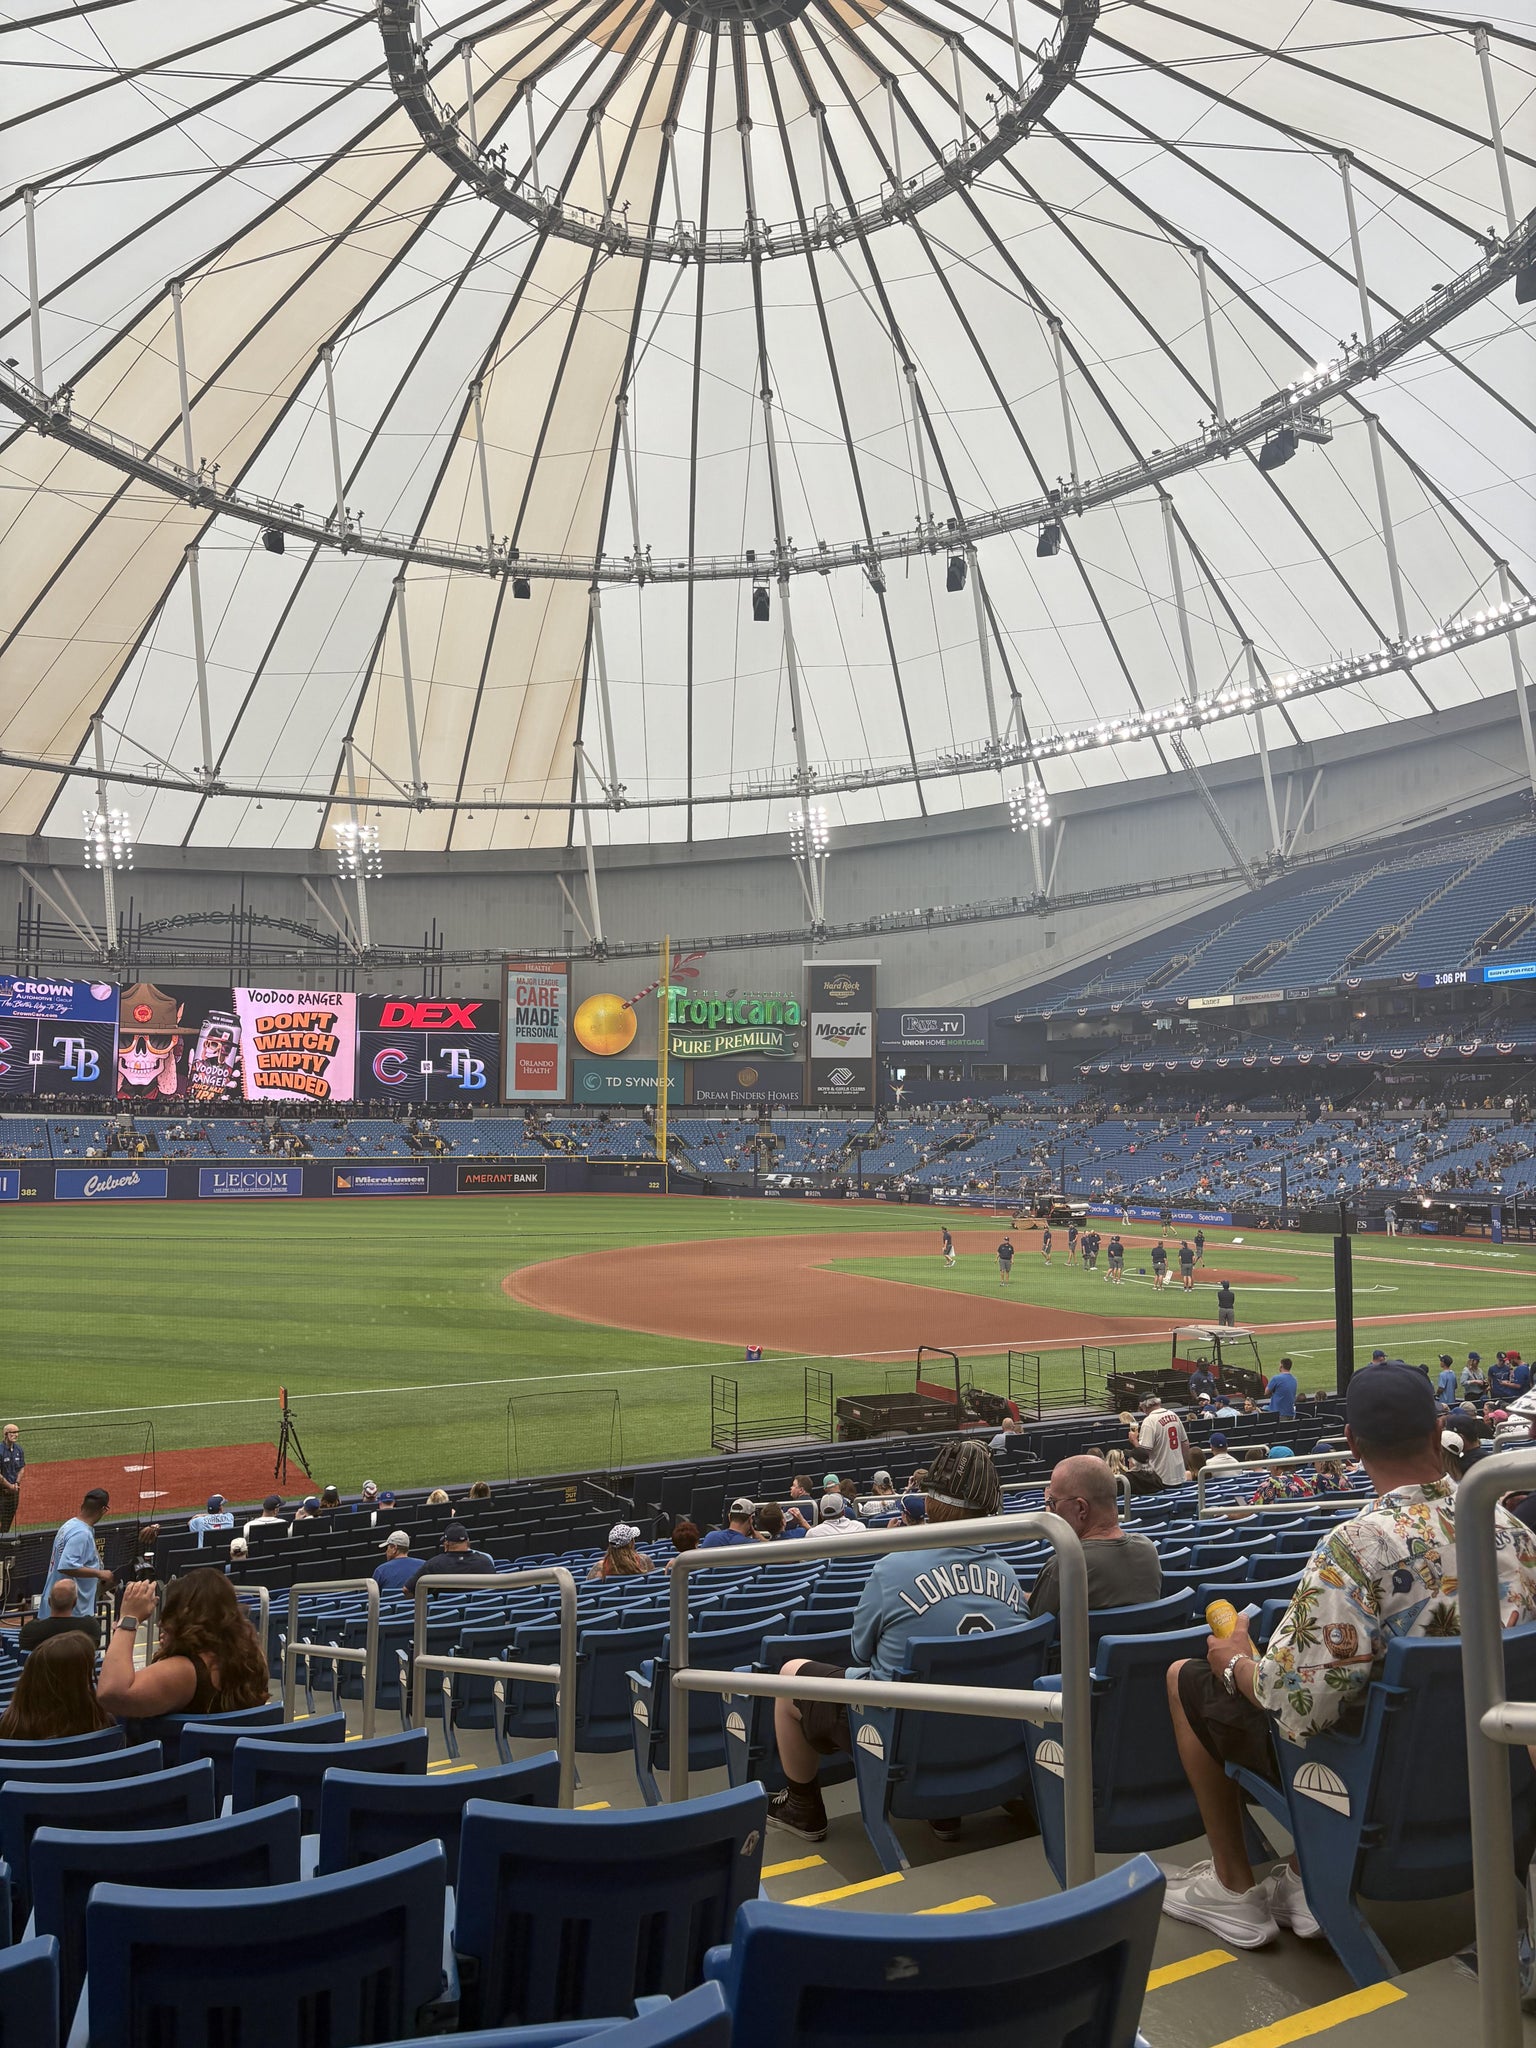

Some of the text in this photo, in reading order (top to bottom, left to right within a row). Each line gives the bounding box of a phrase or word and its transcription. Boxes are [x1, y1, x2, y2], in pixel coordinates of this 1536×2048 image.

[516, 977, 559, 987] MAJOR LEAGUE
[824, 981, 860, 991] Hard Rock
[1434, 971, 1467, 985] 3:06 PM
[12, 981, 74, 997] CROWN
[516, 985, 560, 1008] CARE
[1, 997, 13, 1007] The
[16, 993, 53, 1002] AUTOMOTIVE
[247, 990, 343, 1006] VOODOO RANGER
[12, 1010, 58, 1018] CrownCars.com
[657, 985, 801, 1029] Tropicana
[255, 1012, 338, 1034] DON'T
[379, 1002, 483, 1029] DEX
[516, 1007, 559, 1027] MADE
[516, 1026, 559, 1039] PERSONAL
[816, 1023, 867, 1036] Mosaic
[253, 1032, 340, 1057] WATCH
[672, 1032, 783, 1054] PURE PREMIUM
[53, 1037, 100, 1082] TB
[256, 1053, 330, 1077] EMPTY
[372, 1048, 408, 1085] C
[520, 1059, 554, 1068] ORLANDO
[195, 1062, 230, 1078] VOODOO
[440, 1048, 487, 1090] TB
[523, 1067, 551, 1075] HEALTH
[191, 1073, 228, 1087] RANGER
[253, 1072, 332, 1099] HANDED
[606, 1077, 675, 1088] TD SYNNEX
[696, 1090, 799, 1100] DREAM FINDERS HOMES
[83, 1171, 141, 1197] Culver's
[354, 1175, 425, 1183] MicroLumen
[465, 1174, 539, 1183] AMERANT BANK
[21, 1188, 37, 1196] 382
[1198, 1213, 1224, 1221] Spectrum
[1168, 1426, 1179, 1450] 8
[899, 1562, 1020, 1616] LONGORIA
